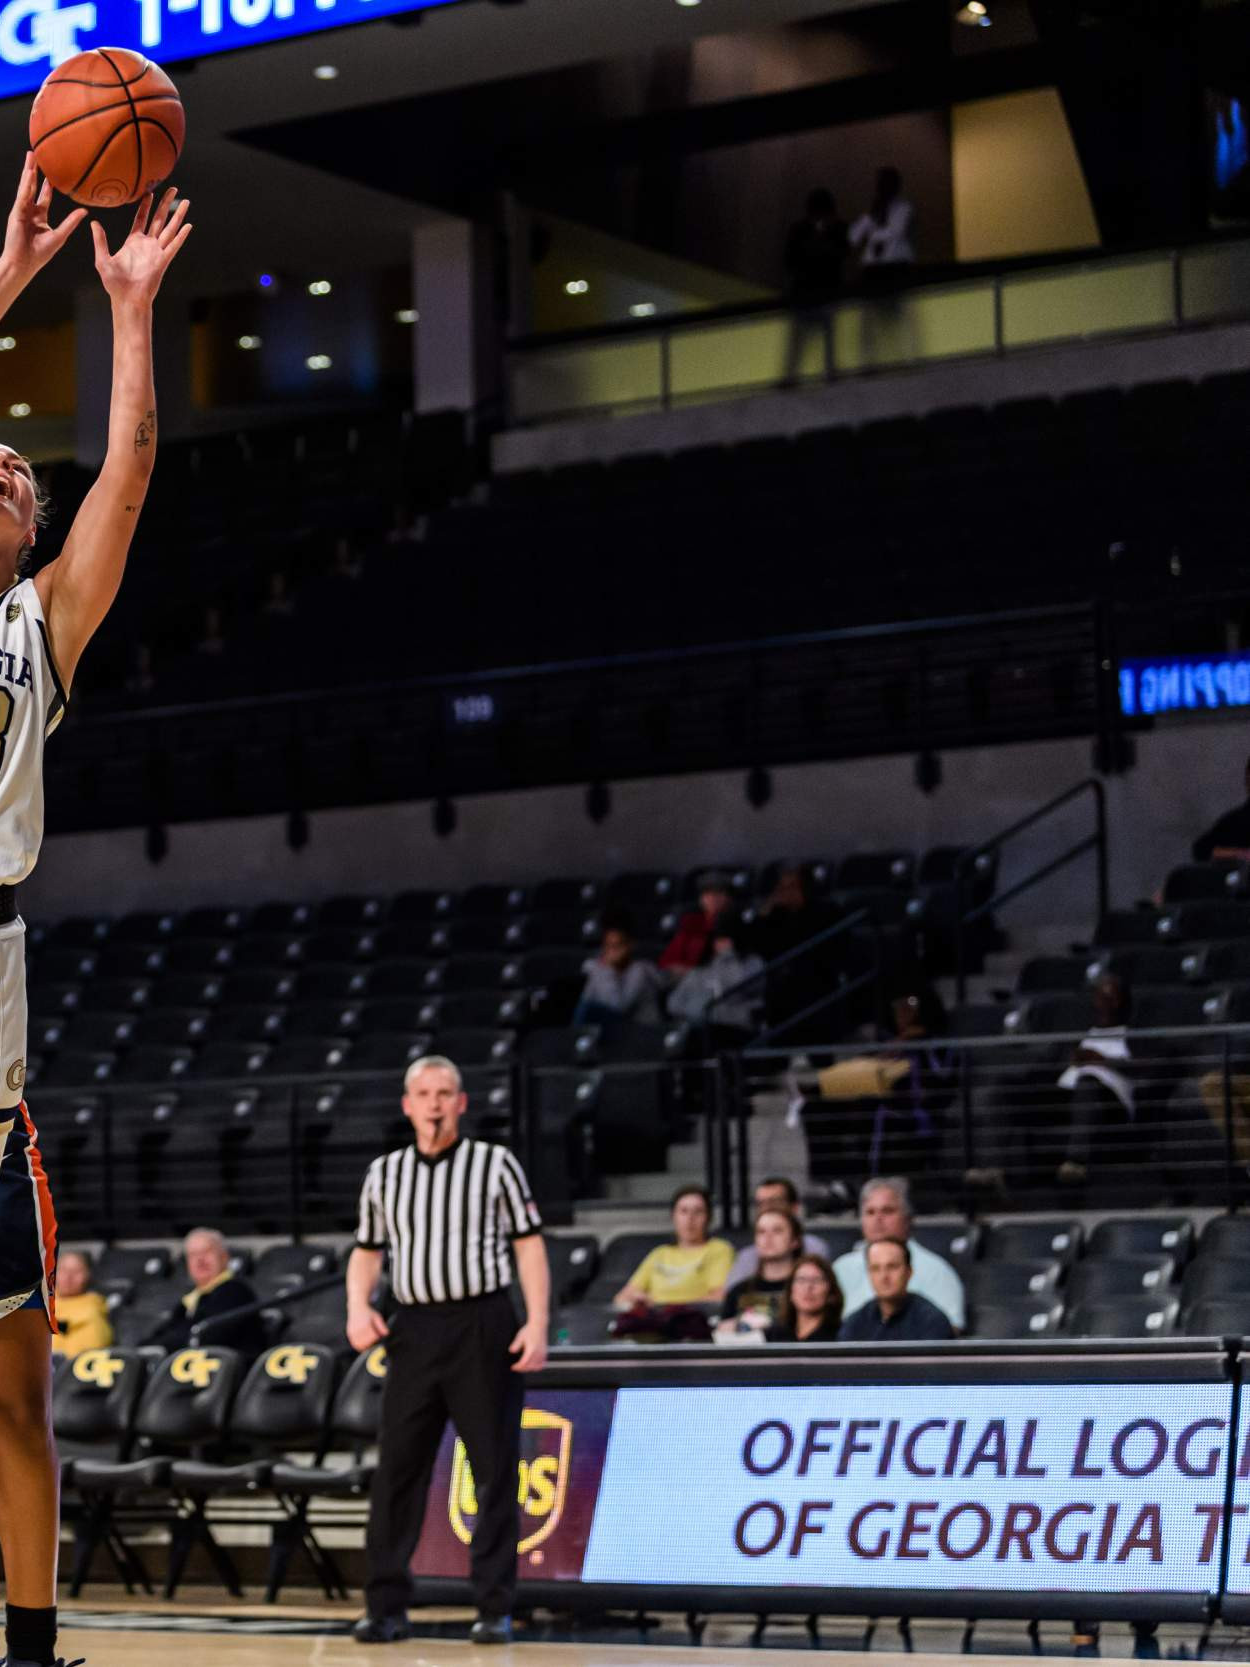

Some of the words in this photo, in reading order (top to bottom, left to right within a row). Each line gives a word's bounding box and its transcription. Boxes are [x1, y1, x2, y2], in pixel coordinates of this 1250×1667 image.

[742, 1418, 1048, 1478] OFFICIAL
[734, 1500, 835, 1558] OF
[847, 1501, 1165, 1563] GEORGIA
[1193, 1502, 1250, 1567] T
